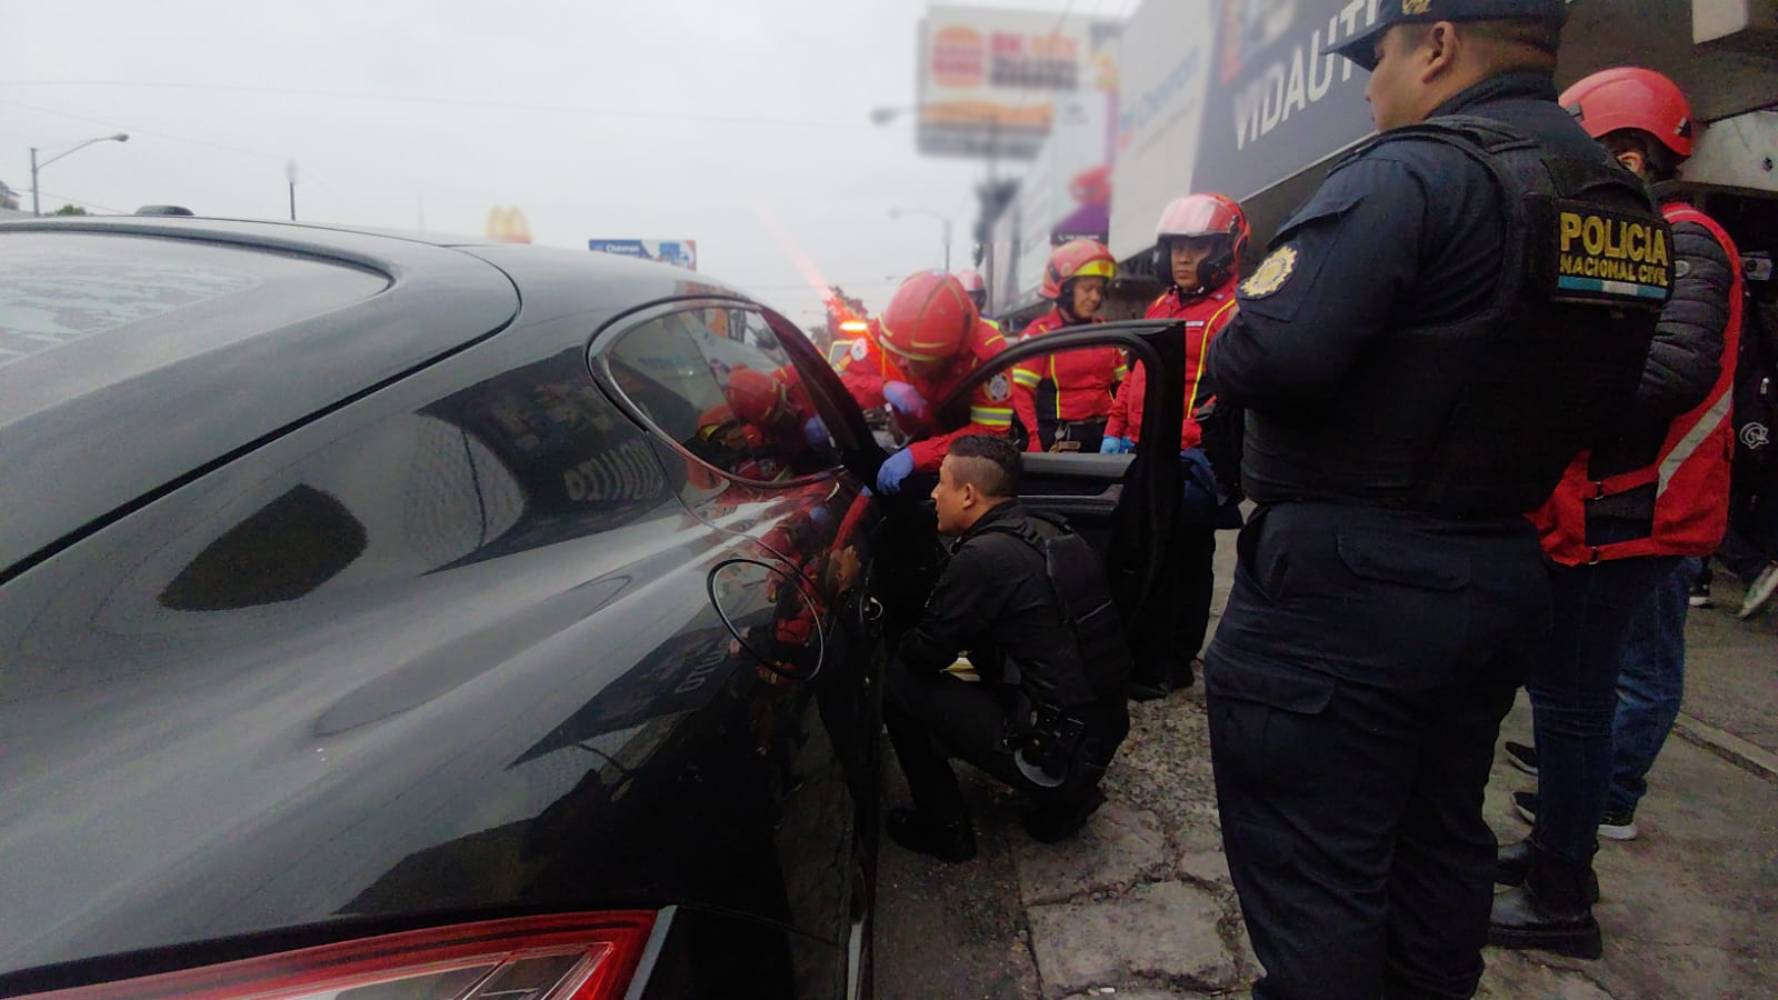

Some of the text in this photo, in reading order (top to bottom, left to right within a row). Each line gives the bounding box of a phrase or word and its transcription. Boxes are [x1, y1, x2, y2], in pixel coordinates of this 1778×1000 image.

[1560, 211, 1668, 266] POLICIA
[1559, 254, 1669, 286] NACIONAL CIVIL
